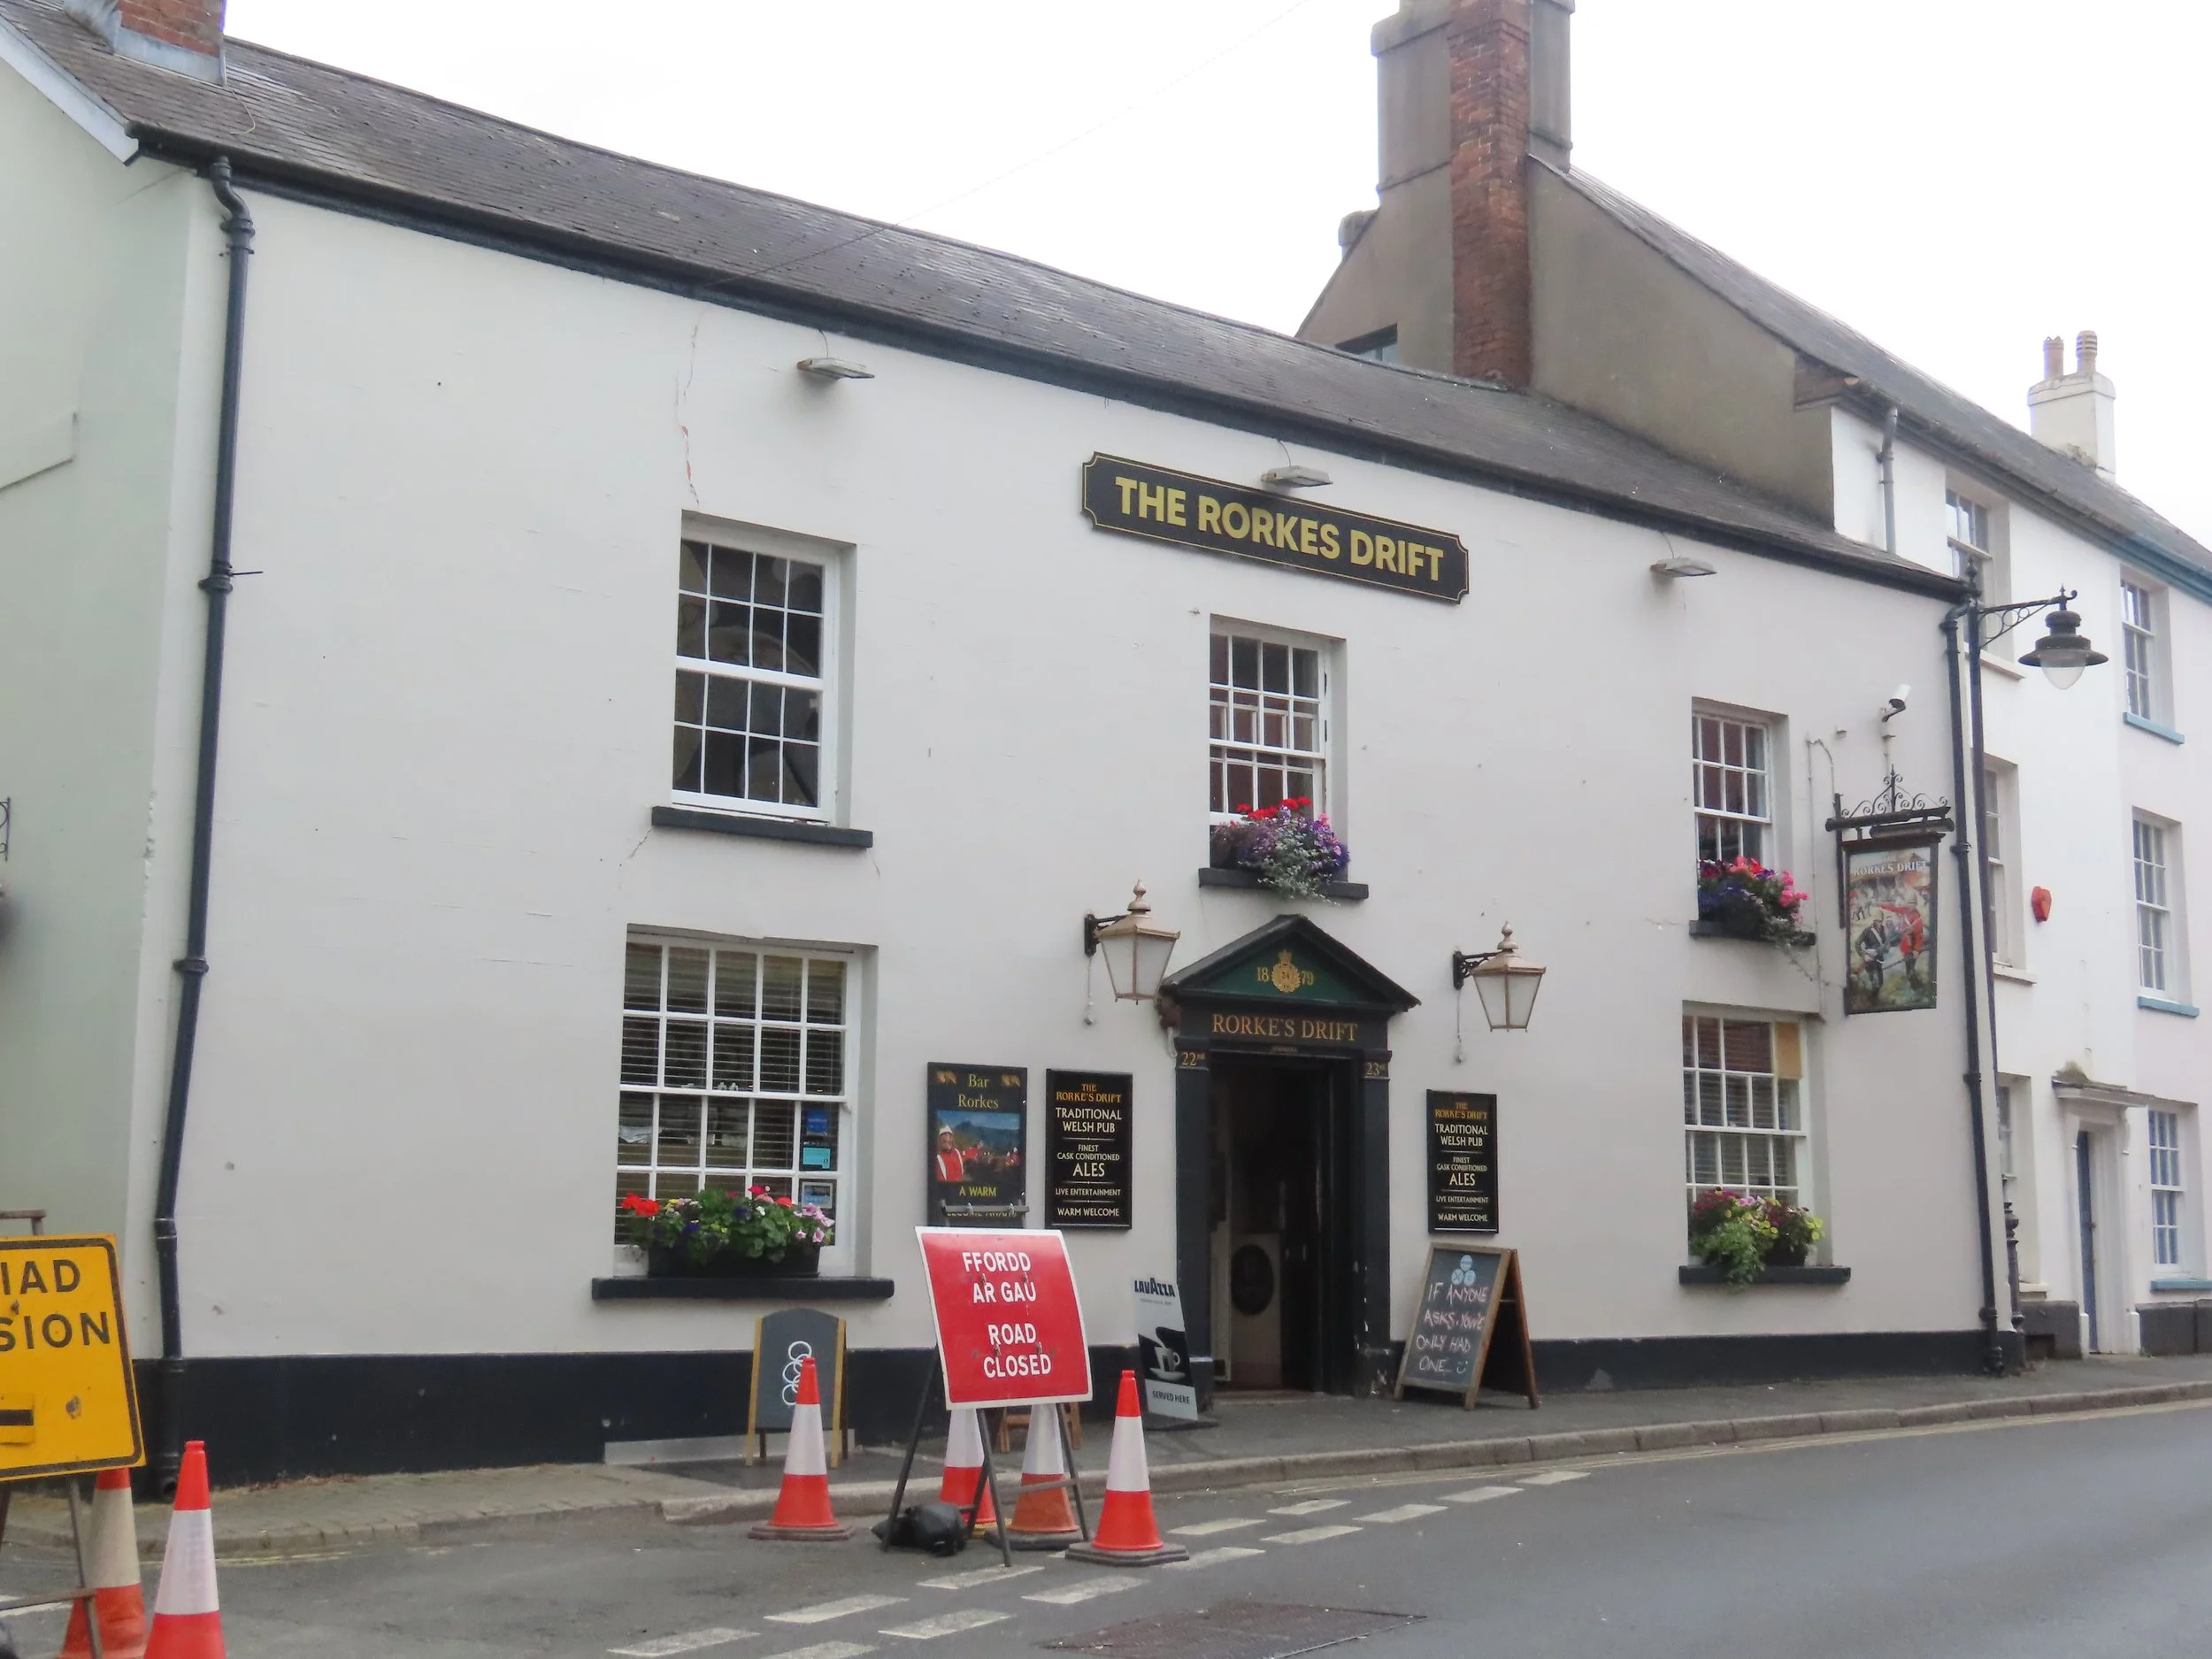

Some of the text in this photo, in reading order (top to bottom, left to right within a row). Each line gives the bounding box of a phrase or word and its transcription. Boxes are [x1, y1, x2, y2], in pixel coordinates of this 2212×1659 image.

[1115, 477, 1444, 581] THE RORKES DRIFT
[1897, 861, 1926, 872] DRIFT
[1257, 966, 1270, 982] 18
[1302, 971, 1314, 985] 79
[1213, 1014, 1359, 1041] RORKE'S DRIFT
[968, 1073, 989, 1087] Bar
[1081, 1083, 1097, 1092] THE
[958, 1094, 999, 1109] Rorkes
[1056, 1091, 1122, 1102] RORKE'S DRIFT
[1056, 1107, 1122, 1120] TRADITIONAL
[1467, 1110, 1486, 1119] DRIFT
[1063, 1121, 1116, 1133] WELSH PUB
[1434, 1123, 1488, 1135] TRADITIONAL
[1440, 1135, 1483, 1147] WELSH PUB
[1072, 1162, 1105, 1177] ALES
[1449, 1172, 1475, 1186] ALES
[959, 1187, 997, 1197] A WARM
[1057, 1207, 1120, 1217] WARM WELCOME
[962, 1251, 1031, 1272] FFORDD
[973, 1281, 1036, 1303] AR GAU
[1134, 1278, 1175, 1297] LAVAZZA
[1428, 1282, 1488, 1305] IF ANYONE
[987, 1323, 1036, 1345] ROAD
[1417, 1334, 1471, 1353] ONLY HAD
[983, 1354, 1052, 1379] CLOSED
[1152, 1390, 1190, 1404] SERVED HERE
